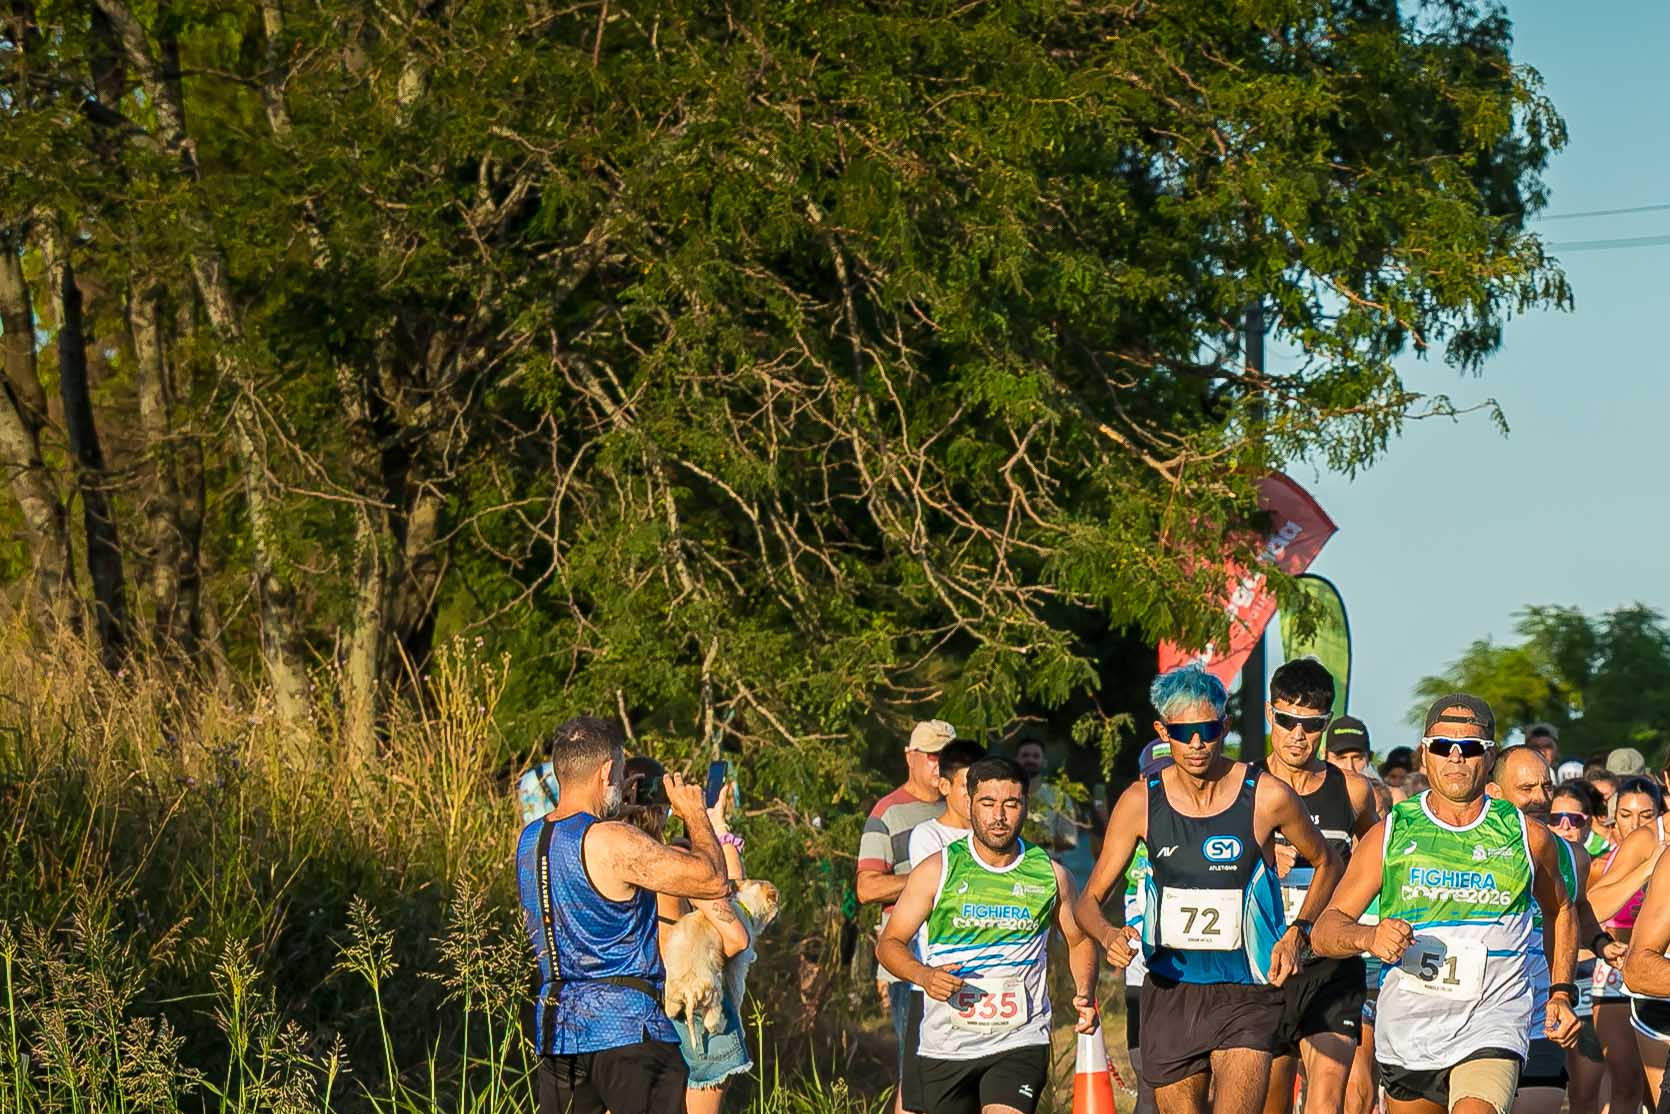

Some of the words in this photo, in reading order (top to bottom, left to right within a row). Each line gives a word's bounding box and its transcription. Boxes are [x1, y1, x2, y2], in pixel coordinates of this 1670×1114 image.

[1409, 867, 1497, 890] FIGHIERA
[962, 904, 1032, 920] FIGHIERA
[1180, 906, 1221, 935] 72
[1418, 951, 1461, 986] 51
[958, 992, 1018, 1018] 535
